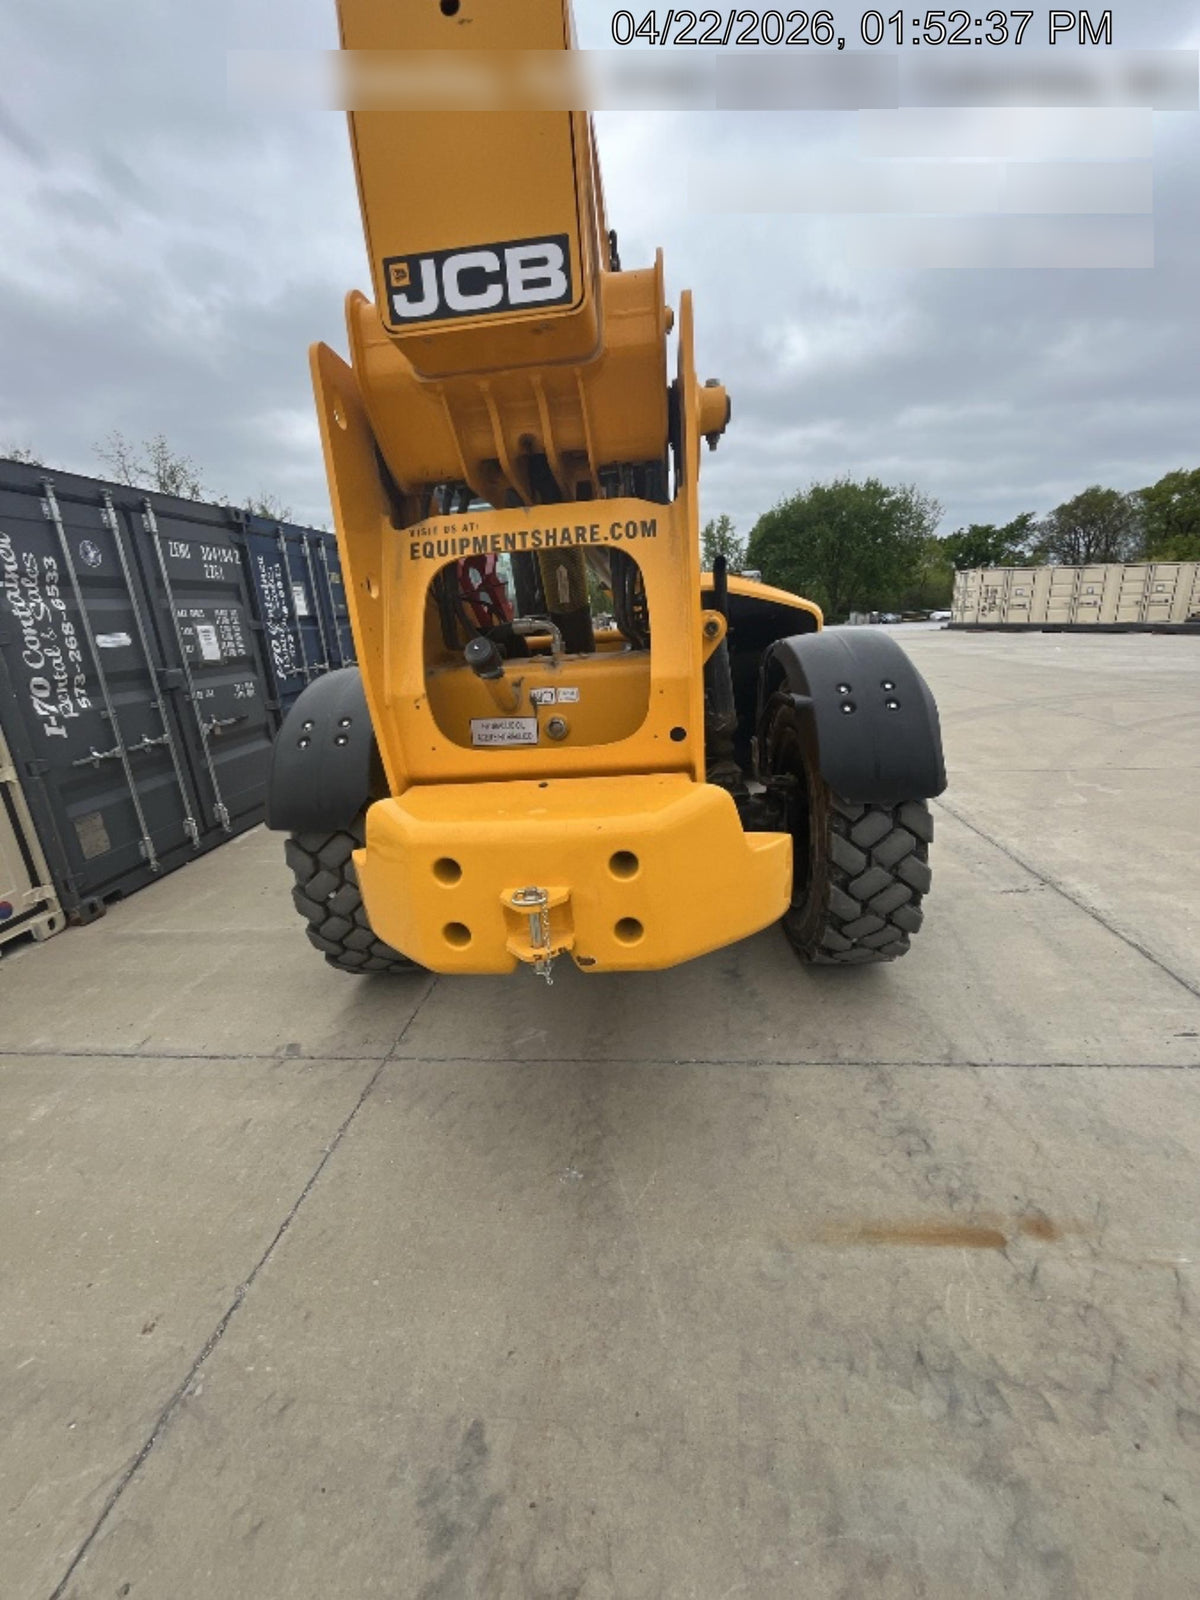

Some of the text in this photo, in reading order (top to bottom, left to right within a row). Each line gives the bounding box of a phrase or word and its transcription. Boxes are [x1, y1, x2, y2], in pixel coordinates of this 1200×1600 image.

[392, 243, 568, 318] JCB
[409, 519, 658, 561] EQUIPMENTSHARE.COM
[20, 552, 52, 623] Sales
[43, 556, 92, 708] 573-268-6533
[30, 676, 68, 738] I-70
